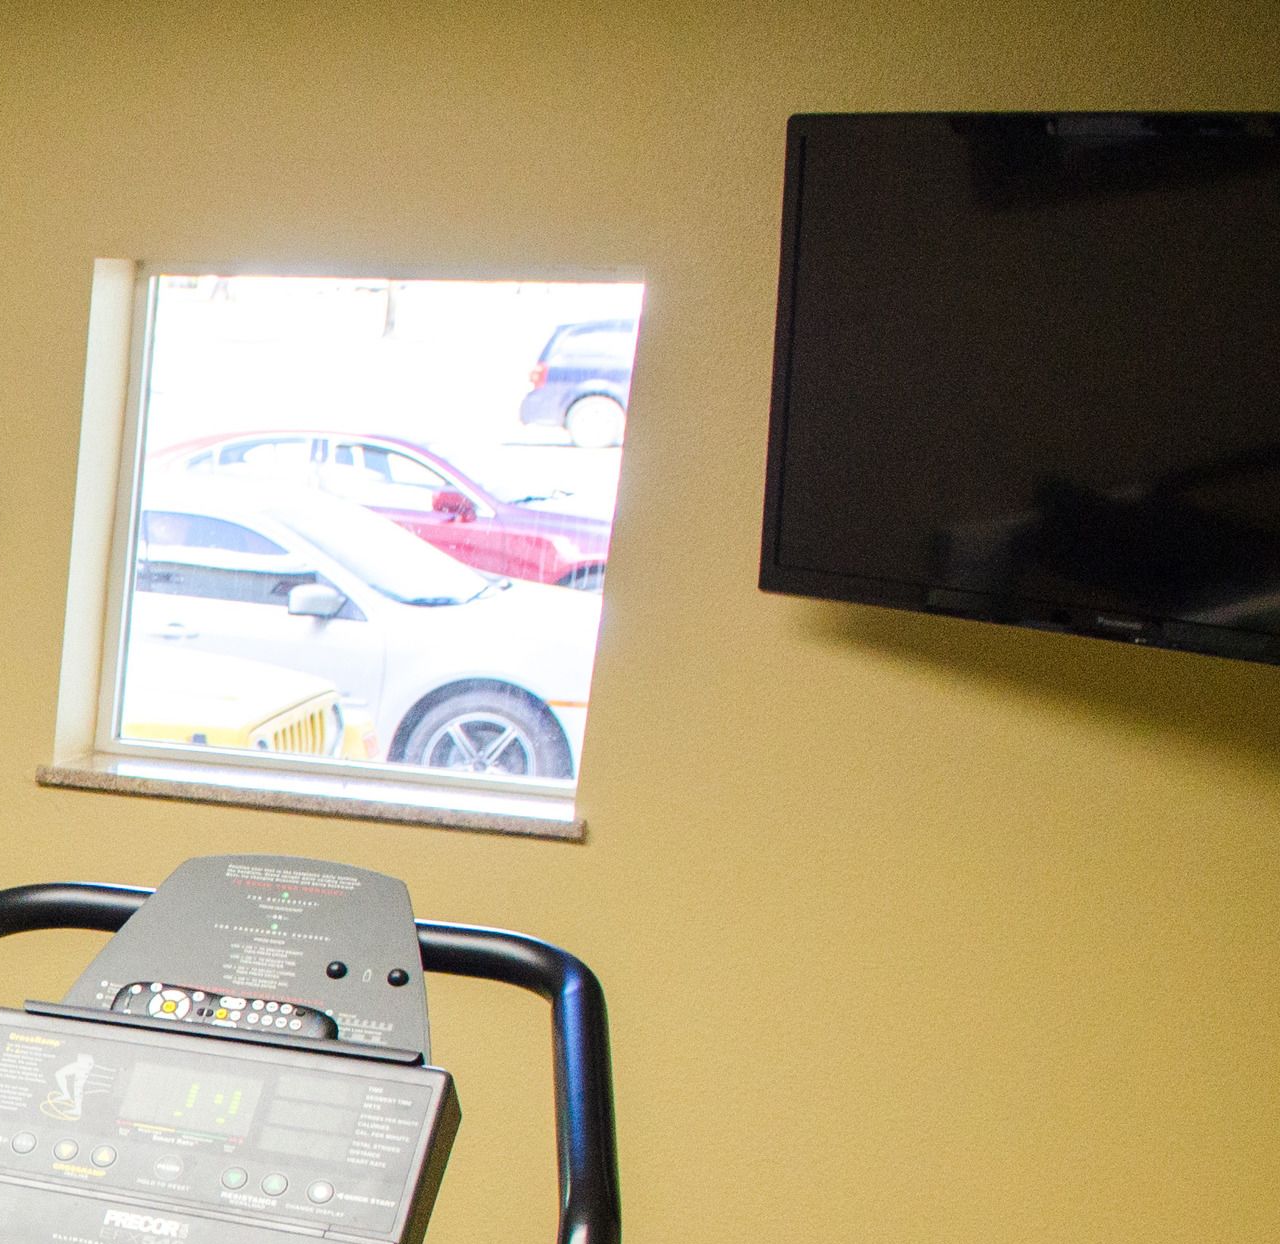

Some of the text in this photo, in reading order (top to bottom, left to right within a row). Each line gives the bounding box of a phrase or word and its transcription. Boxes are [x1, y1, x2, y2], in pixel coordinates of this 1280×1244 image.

[220, 1191, 278, 1207] RESISTANCE
[370, 1197, 396, 1208] START
[103, 1209, 180, 1238] PRECOR
